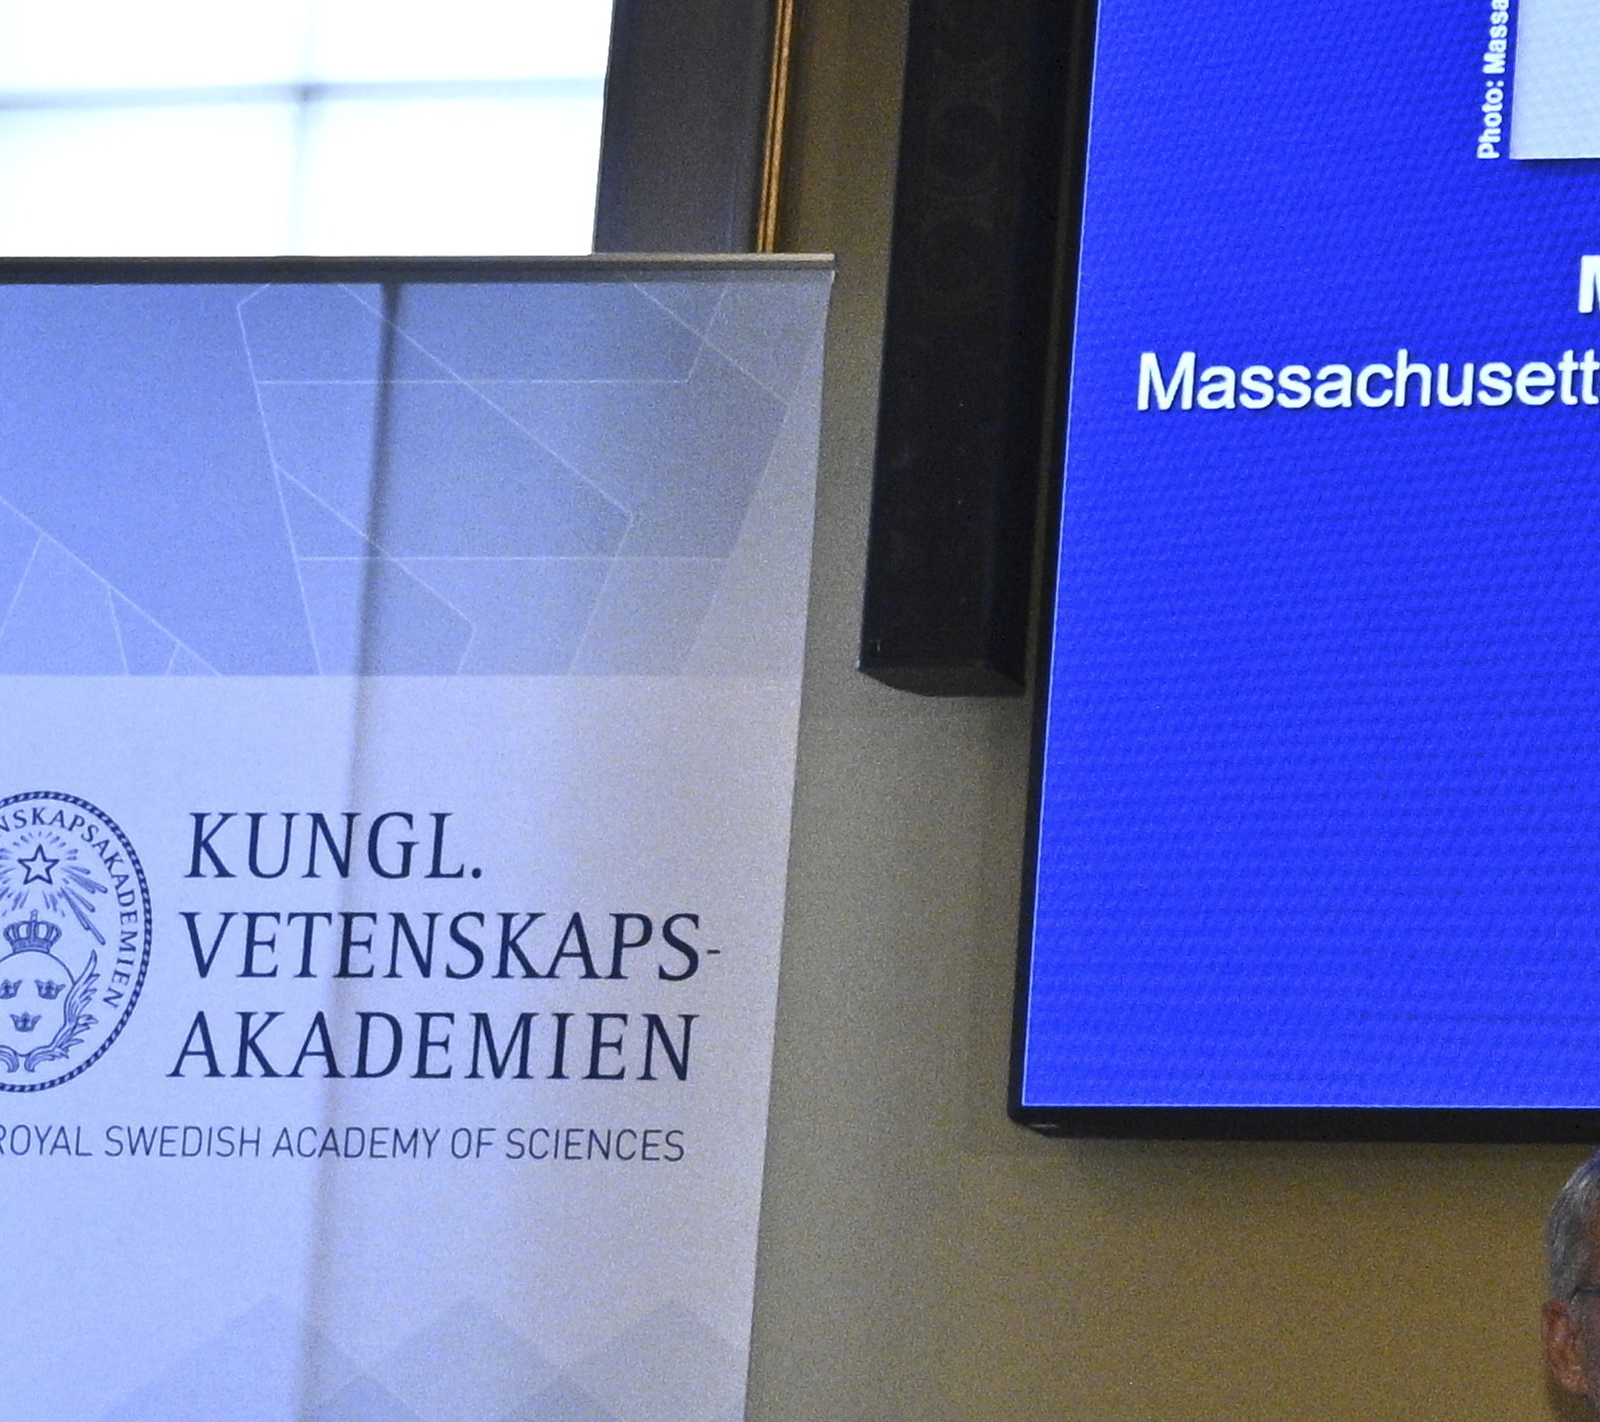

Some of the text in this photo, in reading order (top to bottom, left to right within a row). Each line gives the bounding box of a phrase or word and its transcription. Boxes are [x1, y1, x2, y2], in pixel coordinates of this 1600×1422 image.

[1478, 81, 1503, 158] Photo:
[184, 812, 482, 879] KUNGL.
[179, 911, 721, 982] VETENSKAPS-
[166, 1010, 699, 1081] AKADEMIEN
[104, 1125, 261, 1158] SWEDISH
[272, 1126, 440, 1159] ACADEMY
[451, 1127, 496, 1160] OF
[505, 1128, 684, 1162] SCIENCES
